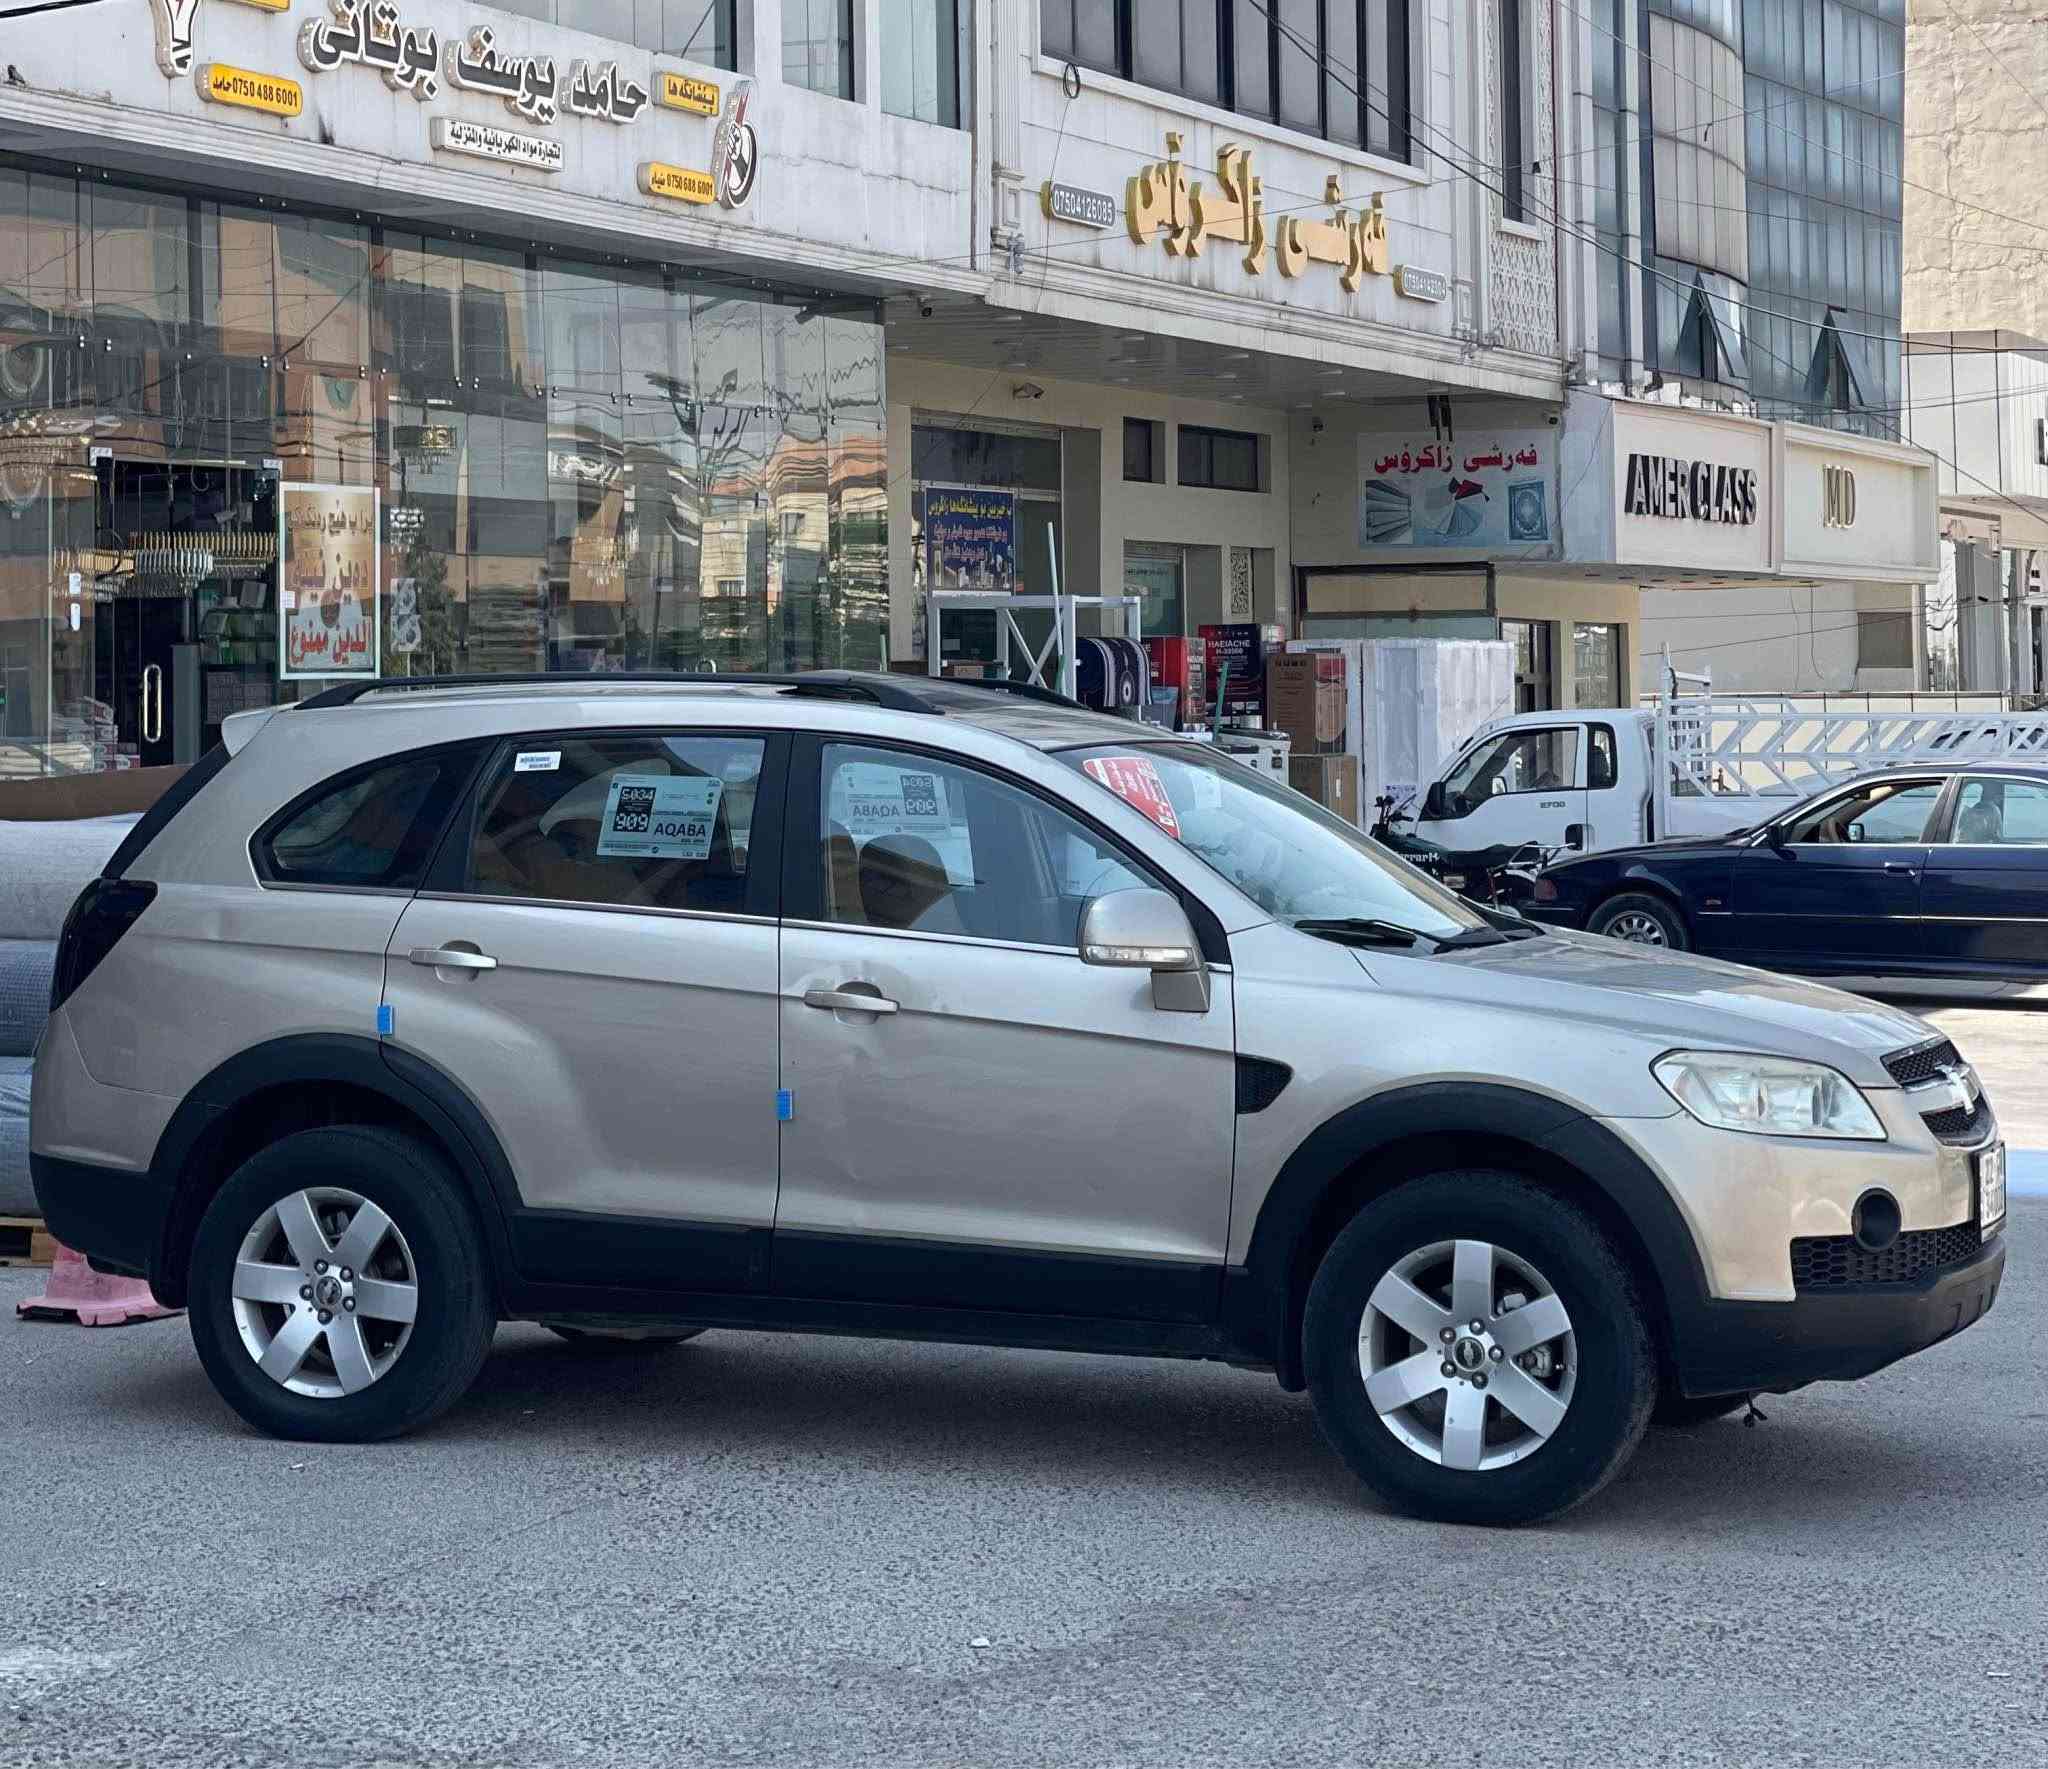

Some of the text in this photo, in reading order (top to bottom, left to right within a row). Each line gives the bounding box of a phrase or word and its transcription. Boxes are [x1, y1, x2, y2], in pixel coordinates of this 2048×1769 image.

[233, 78, 254, 97] 0750
[256, 86, 273, 102] 488
[276, 88, 298, 107] 6001
[573, 61, 648, 120] حامد
[667, 174, 682, 193] 0750
[1822, 463, 1856, 529] MD
[654, 823, 706, 838] AQABA
